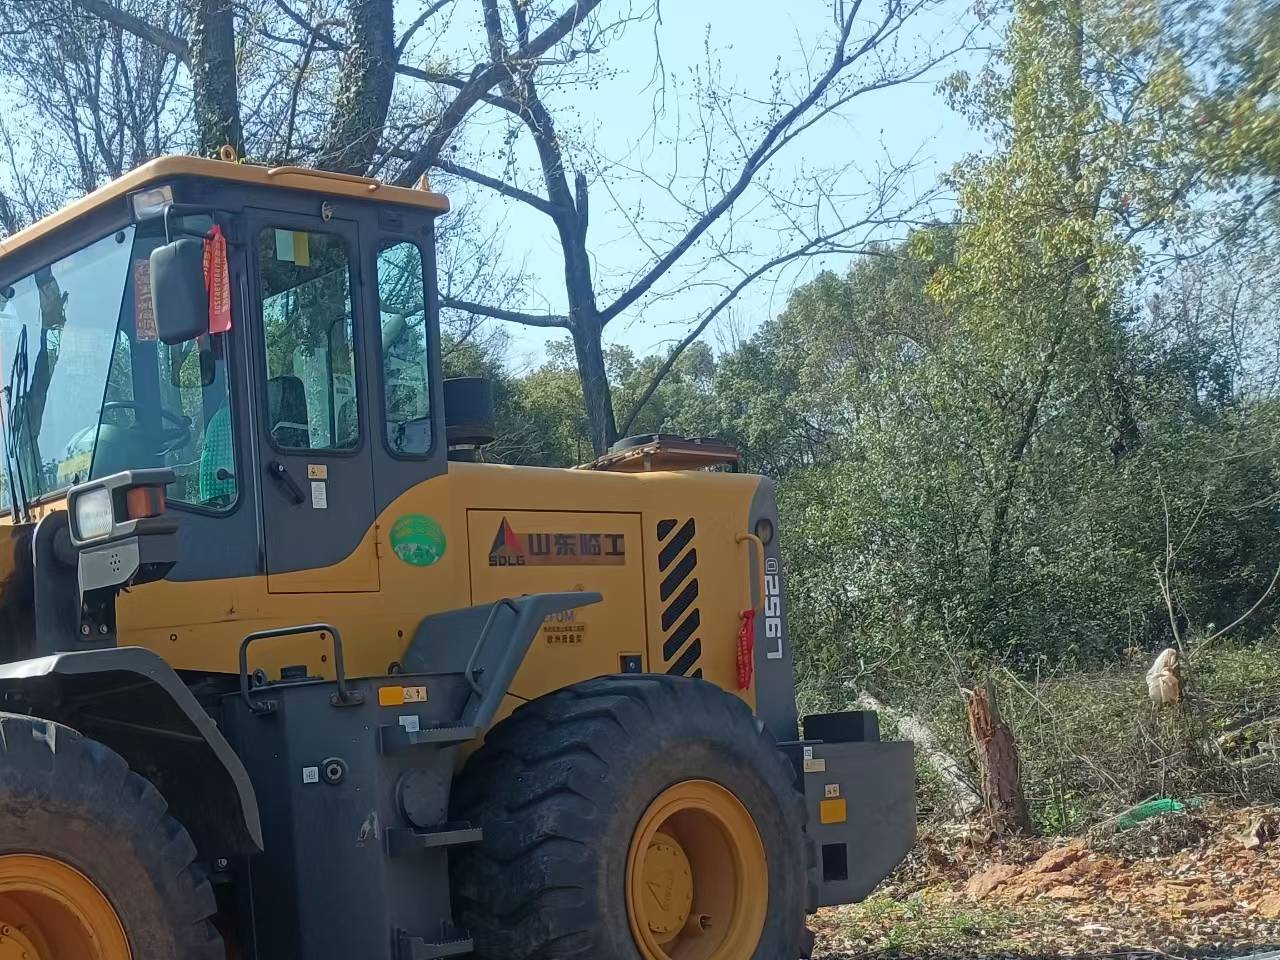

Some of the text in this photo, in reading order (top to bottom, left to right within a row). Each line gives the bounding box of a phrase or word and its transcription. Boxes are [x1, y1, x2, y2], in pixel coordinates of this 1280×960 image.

[528, 533, 625, 556] 山东临工
[489, 555, 525, 567] SDLG
[764, 557, 783, 660] L952D
